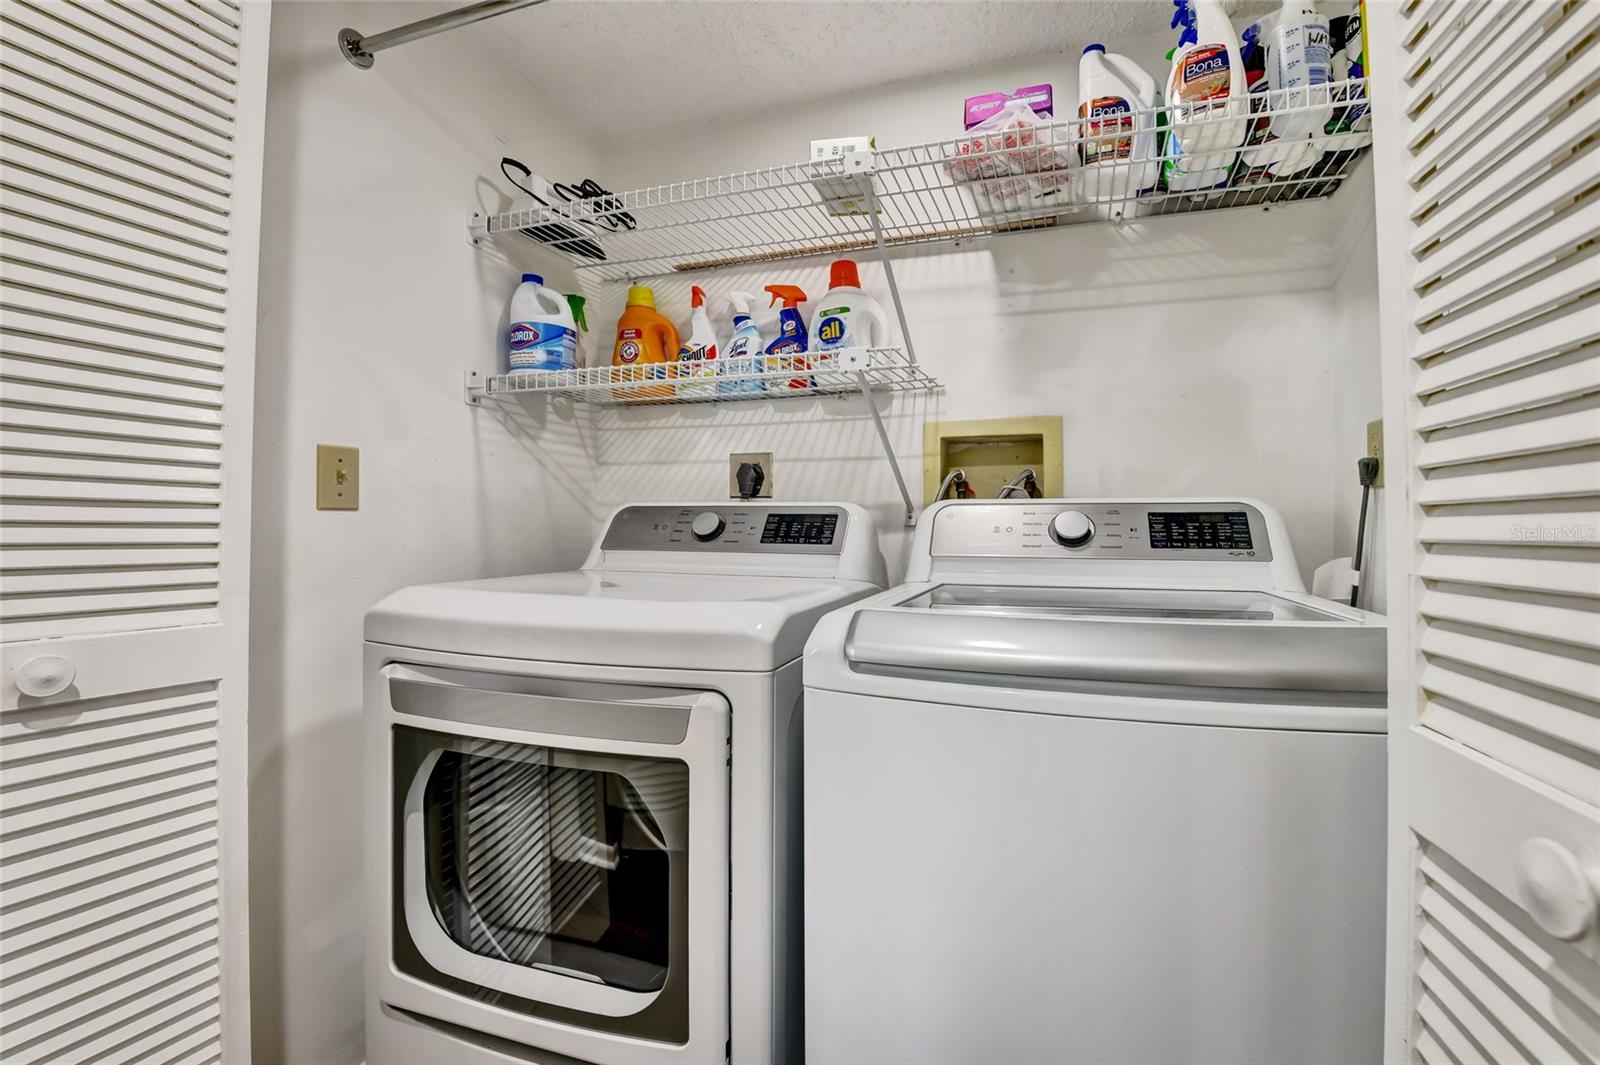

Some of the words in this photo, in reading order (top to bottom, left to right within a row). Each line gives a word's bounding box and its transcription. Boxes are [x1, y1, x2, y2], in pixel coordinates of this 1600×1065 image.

[1186, 58, 1223, 77] Bona
[1093, 106, 1125, 119] Bona
[821, 321, 841, 340] all
[682, 345, 707, 362] SHOUT
